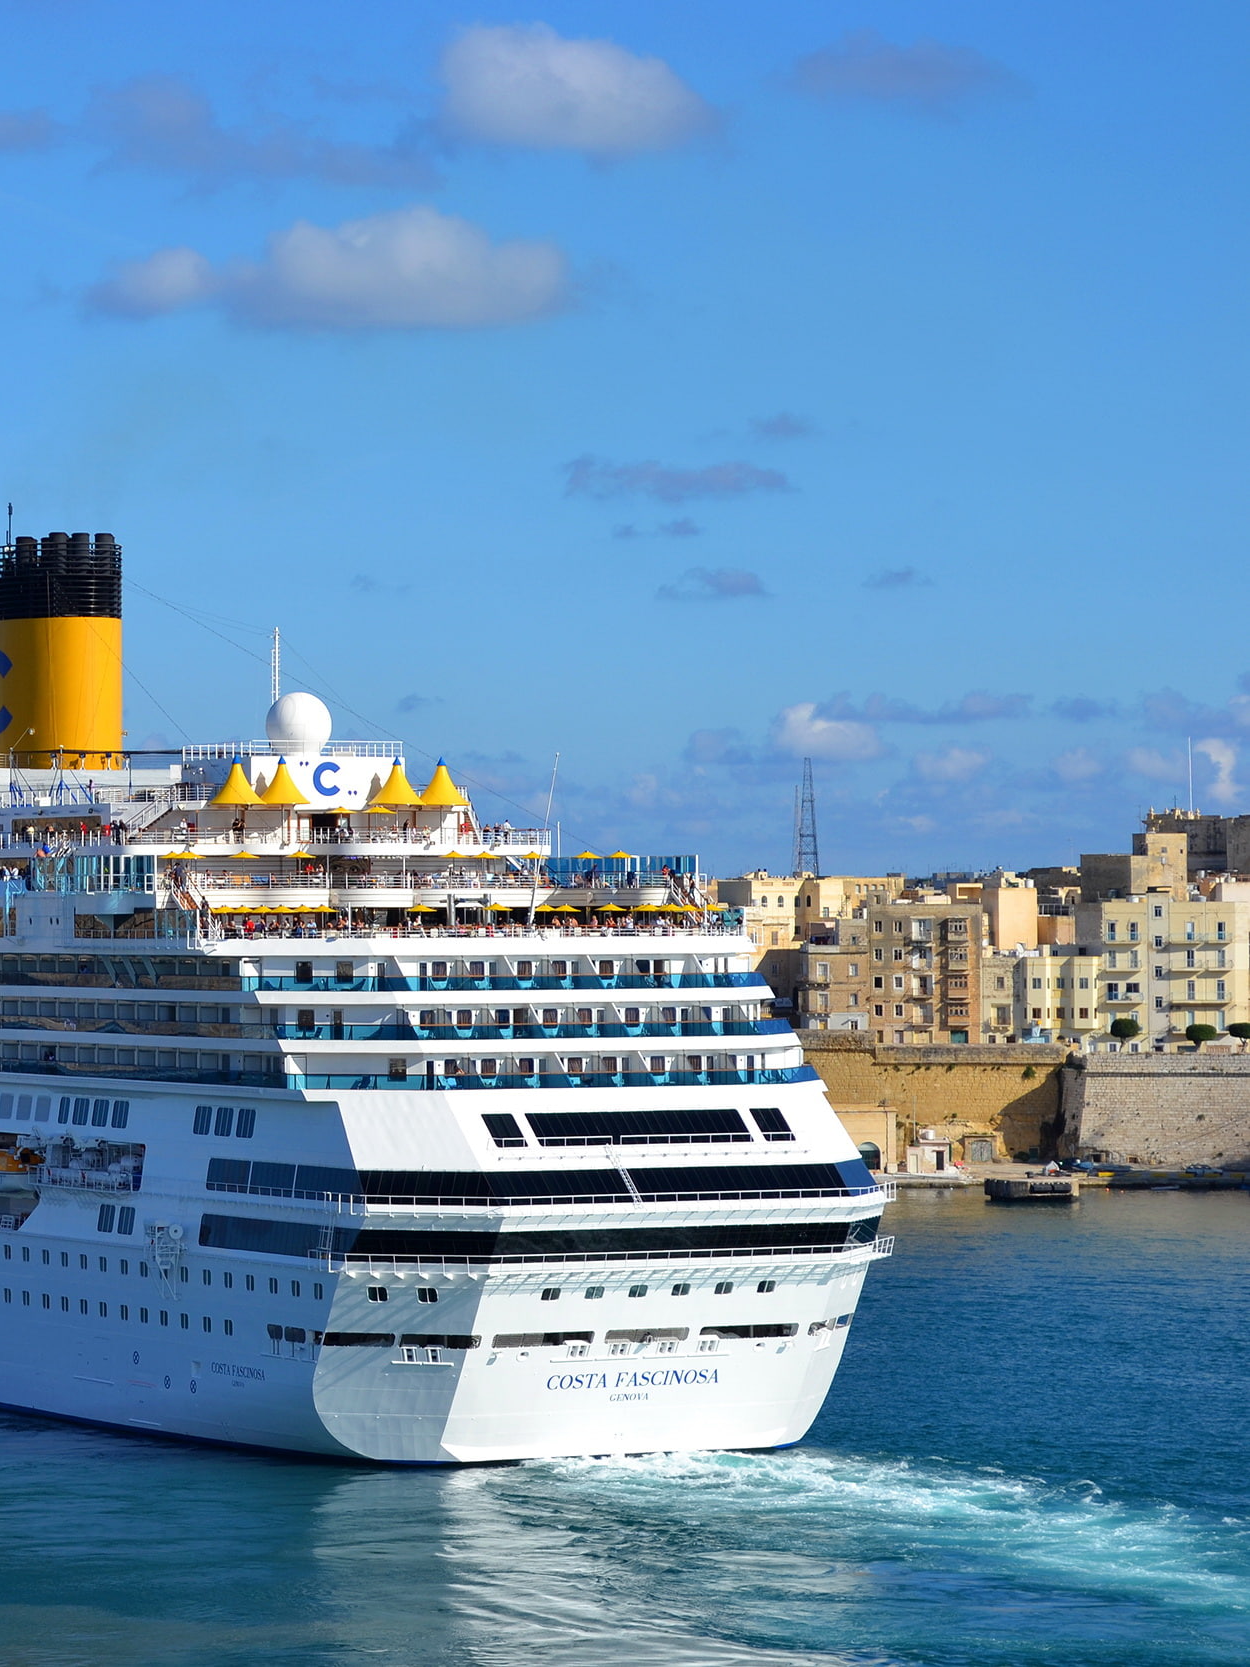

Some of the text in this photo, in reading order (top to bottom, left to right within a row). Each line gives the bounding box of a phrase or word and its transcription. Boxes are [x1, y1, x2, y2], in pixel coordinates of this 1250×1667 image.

[211, 1361, 230, 1376] COSTA
[546, 1368, 719, 1390] COSTA FASCINOSA
[609, 1392, 649, 1402] GENOVA
